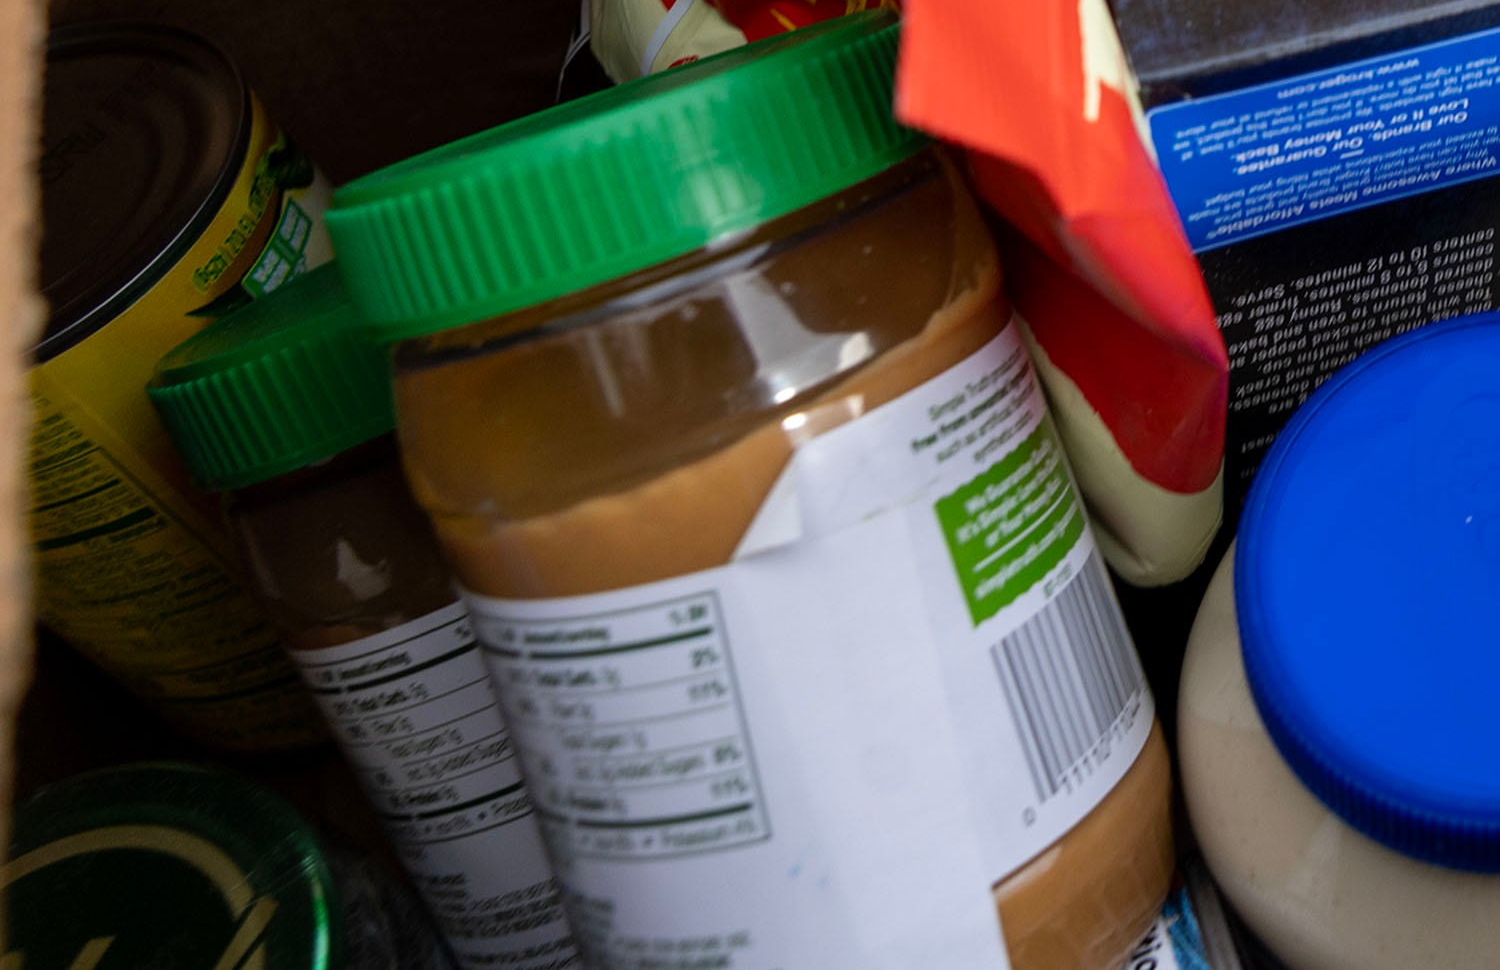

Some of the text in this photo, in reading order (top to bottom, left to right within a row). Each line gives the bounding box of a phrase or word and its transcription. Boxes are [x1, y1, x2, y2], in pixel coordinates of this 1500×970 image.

[1277, 58, 1420, 99] www.kroger.com
[1428, 97, 1469, 115] Love
[1347, 119, 1385, 135] Your
[1390, 113, 1408, 125] or
[1437, 111, 1468, 126] Our
[1284, 129, 1342, 150] Money
[1332, 136, 1364, 152] Our
[1231, 143, 1280, 163] Back.
[1309, 155, 1497, 210] Where Awesome Meets
[1433, 228, 1495, 252] centers
[1433, 243, 1494, 267] centers
[1434, 258, 1494, 284] desired
[1248, 296, 1299, 321] firmer
[1289, 298, 1342, 323] Runny
[1372, 289, 1427, 313] Return
[1426, 295, 1461, 314] with
[1254, 314, 1285, 333] egg
[1308, 311, 1347, 331] oven
[1380, 305, 1422, 326] fresh
[1273, 324, 1303, 344] and
[1312, 318, 1376, 347] cracked
[1353, 328, 1393, 348] each
[1228, 334, 1268, 356] bake
[1251, 336, 1307, 363] pepper
[1297, 340, 1349, 364] muffin
[1235, 364, 1315, 398] and crack
